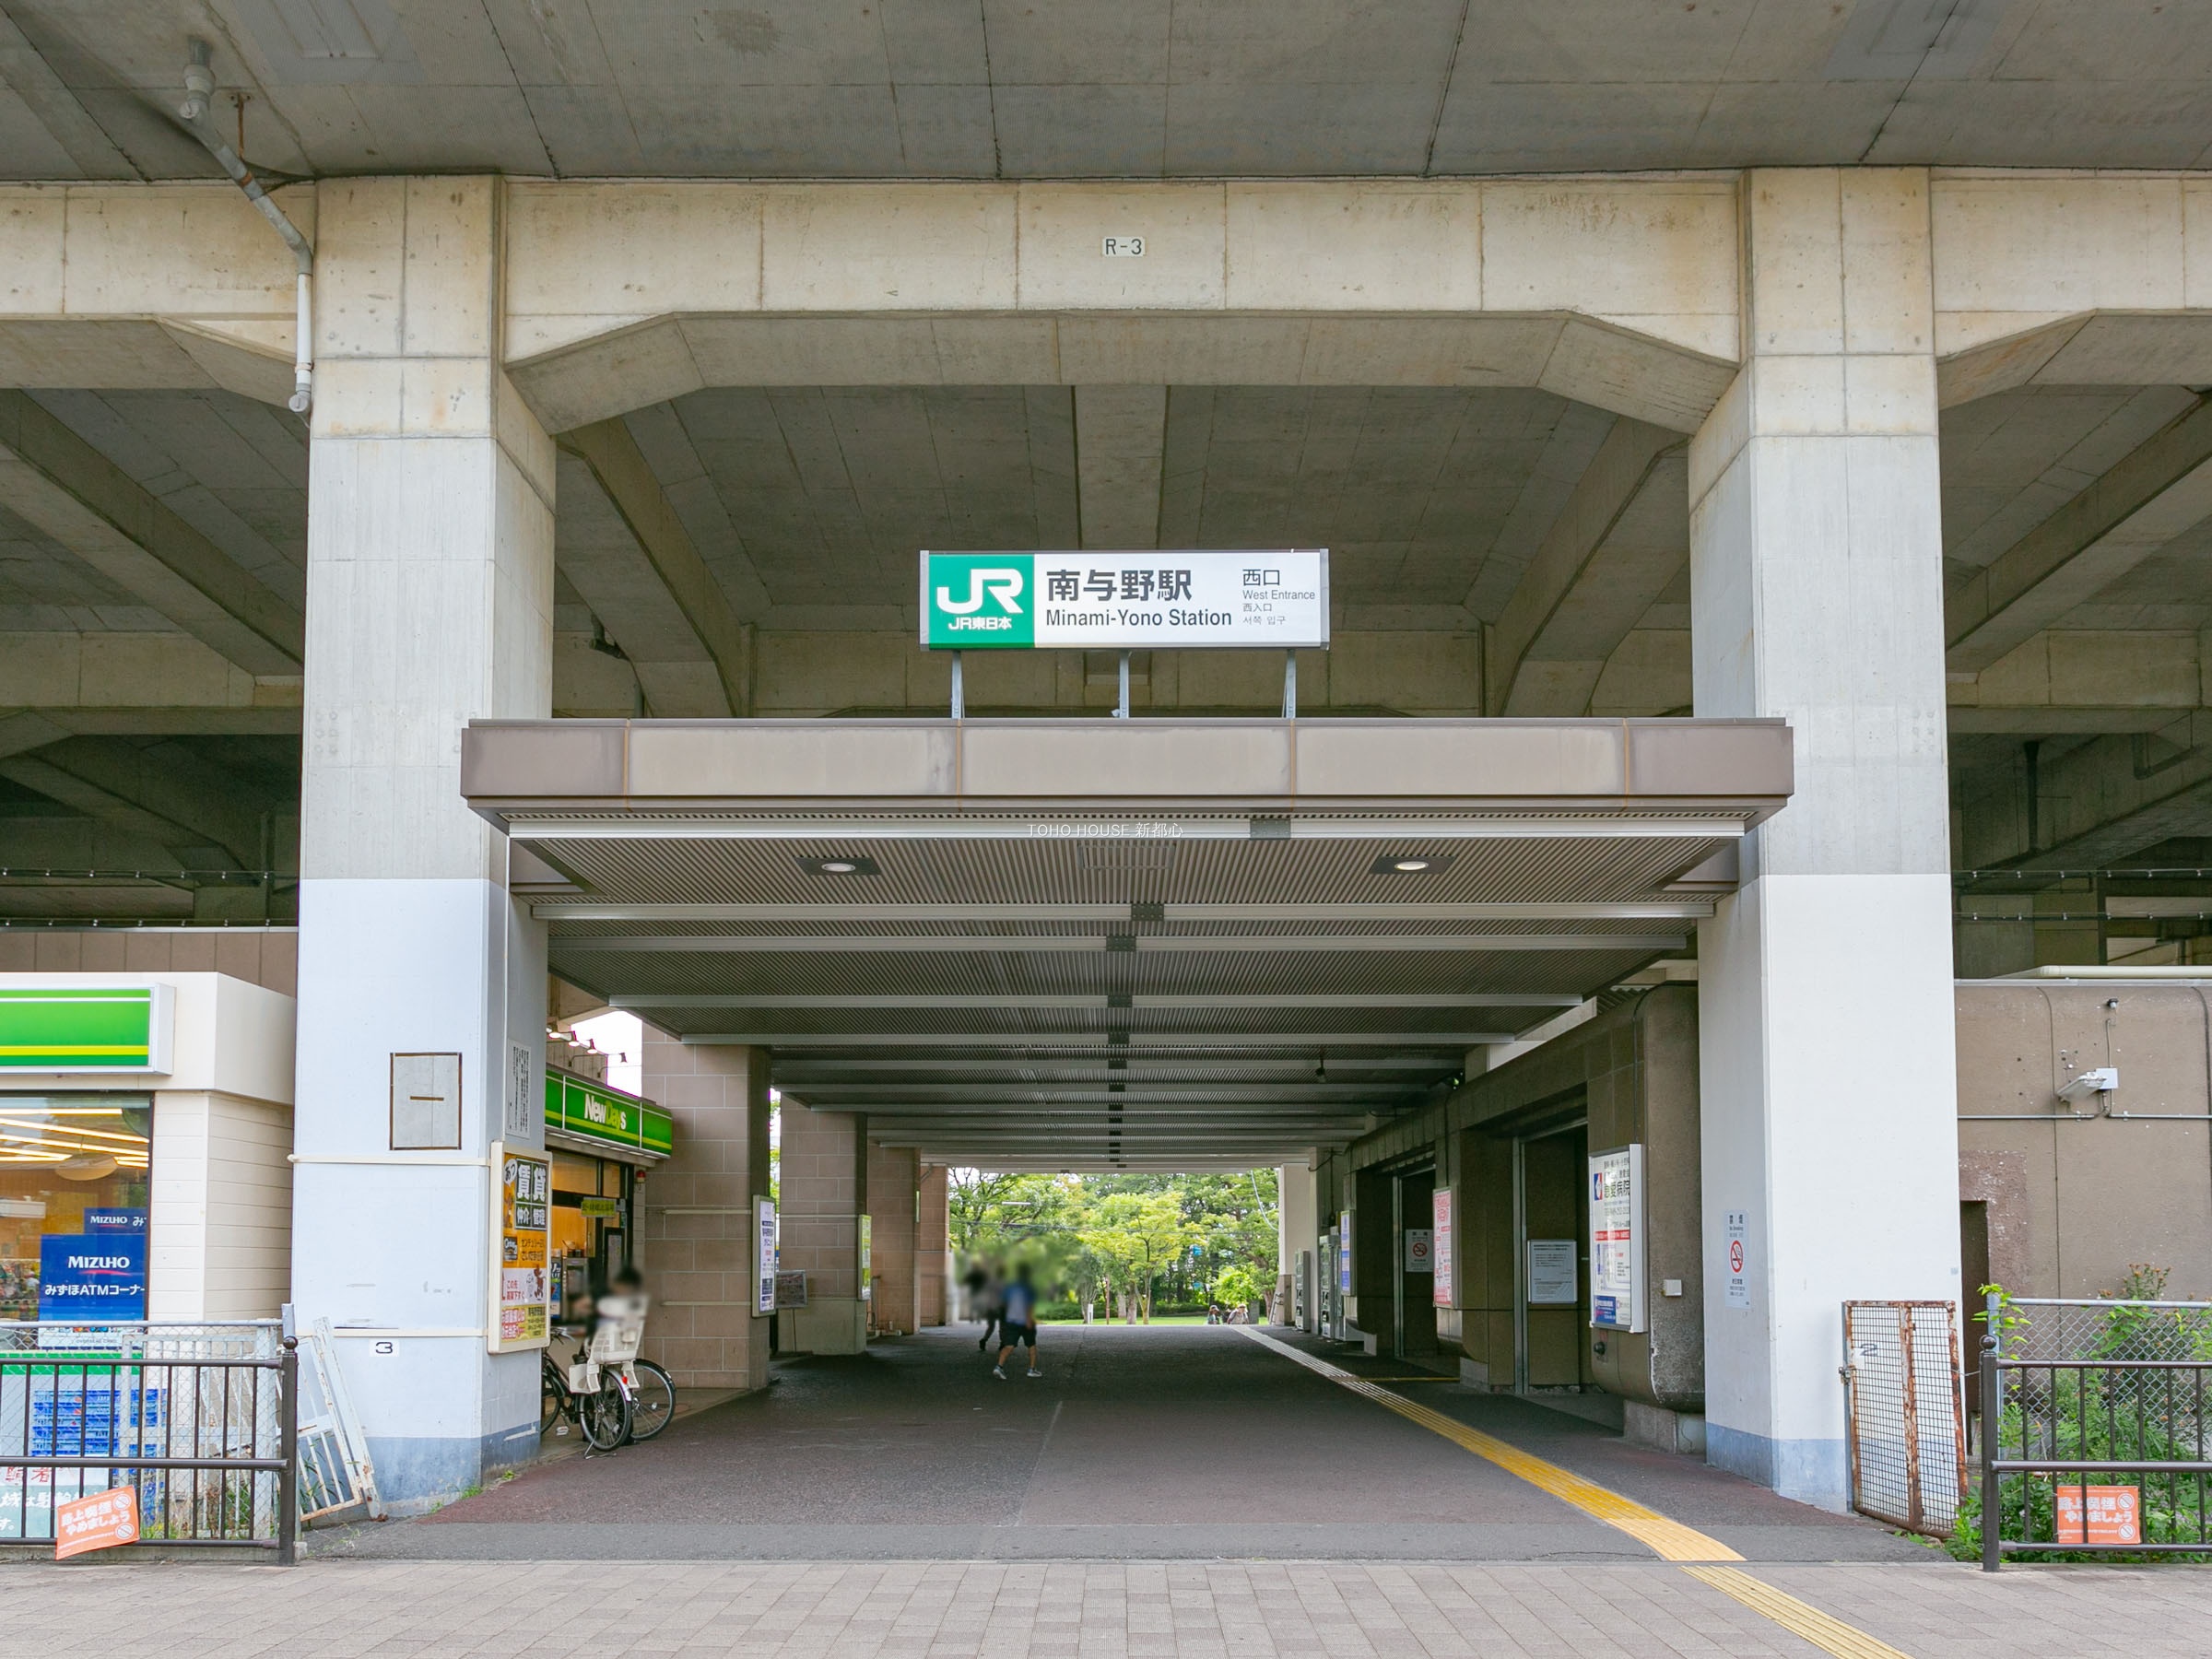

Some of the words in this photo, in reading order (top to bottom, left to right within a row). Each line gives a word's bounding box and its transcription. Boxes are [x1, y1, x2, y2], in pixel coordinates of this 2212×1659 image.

[1105, 238, 1142, 255] R-3
[1242, 569, 1280, 586] 西口
[936, 569, 1024, 614] JR
[1046, 569, 1192, 603] 南与野駅
[1242, 590, 1268, 600] West
[1271, 590, 1315, 600] Entrance
[1242, 603, 1273, 612] 西入口
[947, 616, 1012, 630] JR東日本
[1046, 609, 1163, 627] Minami-Yono
[1169, 609, 1232, 627] Station
[1242, 616, 1263, 625] 서쪽
[1266, 616, 1287, 625] 입구
[584, 1093, 627, 1131] NewDays
[516, 1164, 547, 1202] 賃貸
[90, 1216, 128, 1224] MIZUHO
[132, 1216, 147, 1227] み
[68, 1255, 131, 1269] MIZUHO
[375, 1341, 393, 1354] 3
